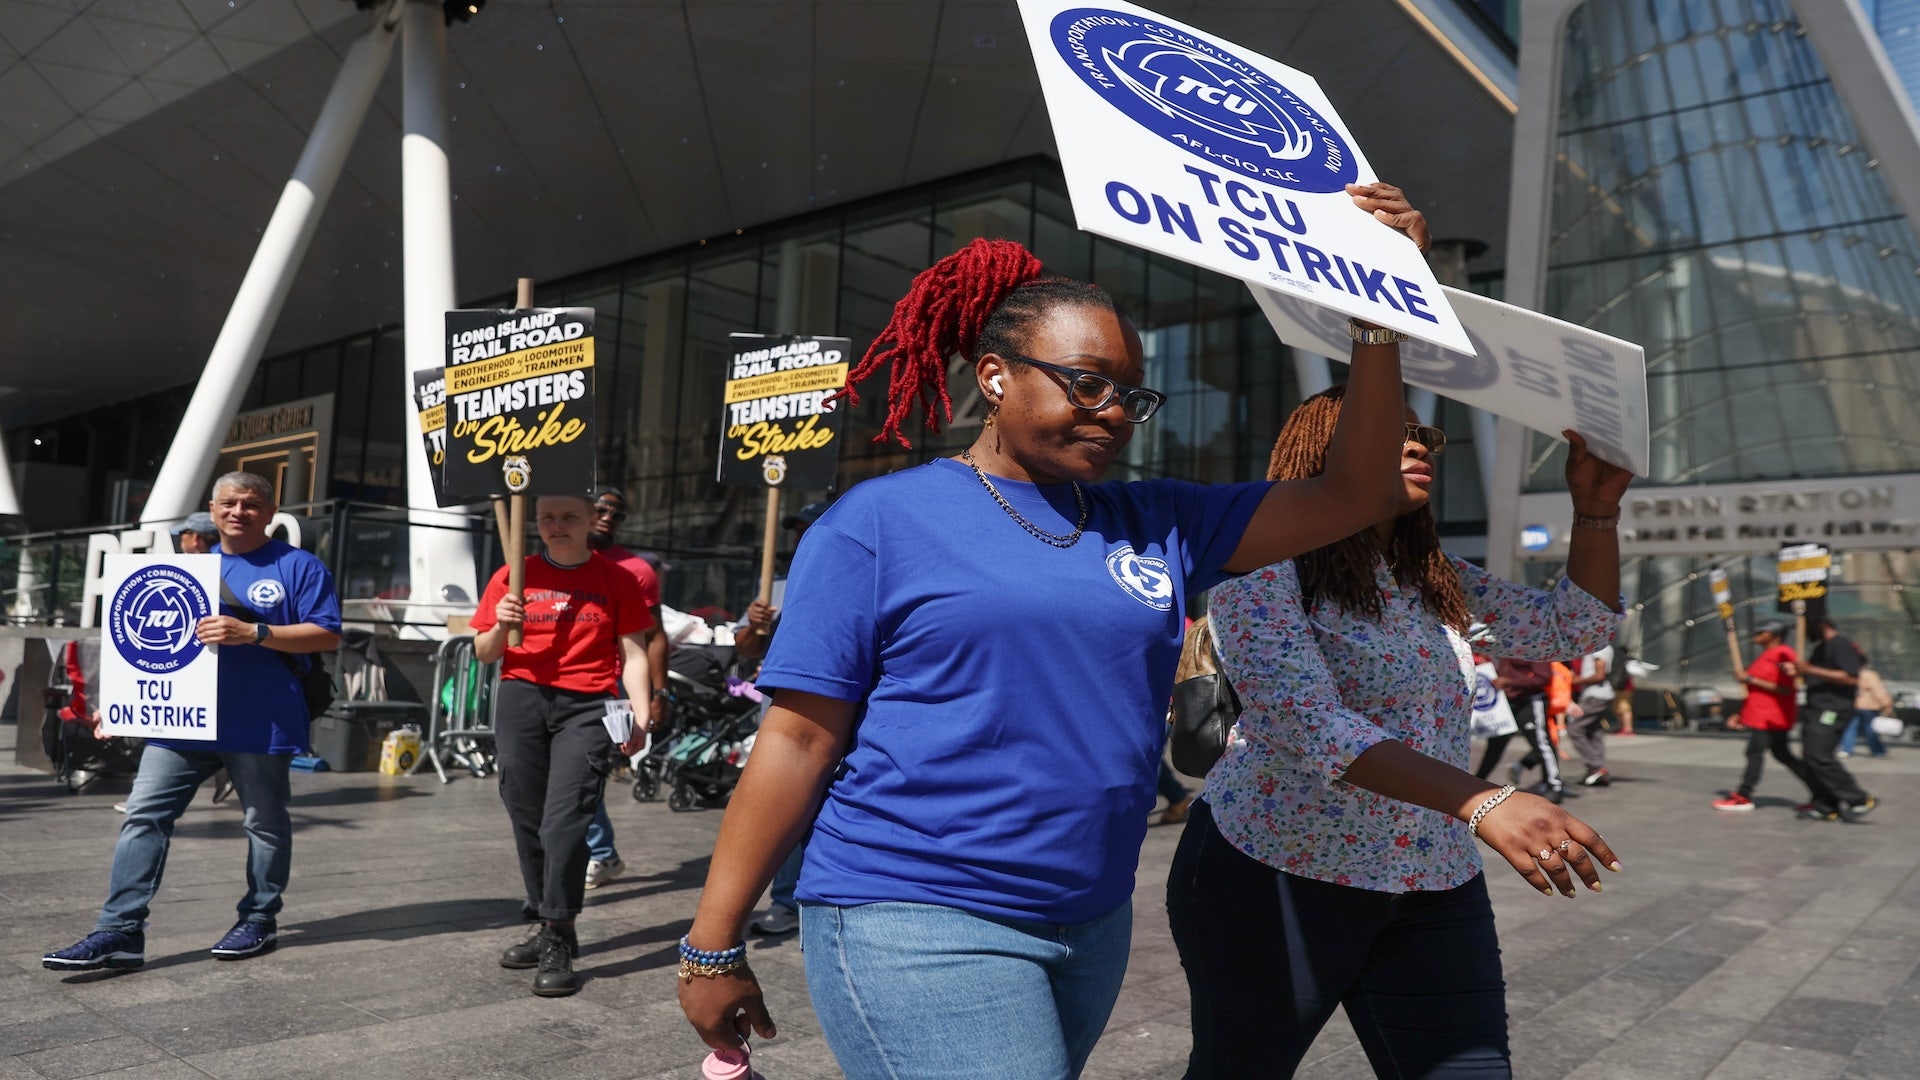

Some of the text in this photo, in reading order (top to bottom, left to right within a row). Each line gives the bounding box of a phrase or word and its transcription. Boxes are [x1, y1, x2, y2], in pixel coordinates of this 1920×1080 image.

[1067, 16, 1343, 174] TRANSPORTATION COMMUNICATIONS UNION
[1174, 75, 1259, 115] TCU
[1183, 164, 1308, 236] TCU
[1104, 181, 1440, 325] ON STRIKE
[452, 313, 556, 348] LONG ISLAND
[452, 322, 585, 365] RAIL ROAD
[454, 357, 515, 379] BROTHERHOOD
[524, 343, 585, 363] LOCOMOTIVE
[732, 349, 842, 380] RAIL ROAD
[733, 340, 820, 366] LONG ISLAND
[420, 378, 446, 397] LON
[454, 369, 510, 390] ENGINEERS
[524, 354, 585, 373] TRAINMEN
[732, 384, 777, 399] ENGINEERS
[789, 377, 839, 390] TRAINMEN
[733, 375, 783, 390] BROTHERHOOD
[790, 367, 840, 381] LOCOMOTIVE
[422, 389, 447, 411] RA
[453, 370, 586, 423] TEAMSTERS
[730, 388, 838, 426] TEAMSTERS
[453, 420, 480, 439] On
[467, 401, 586, 464] Strike
[728, 413, 835, 461] On Strike
[1630, 485, 1895, 517] PENN STATION
[113, 575, 143, 645] TRANSPORTATION
[146, 569, 207, 615] COMMUNICATIONS
[145, 610, 180, 628] TCU
[565, 612, 600, 623] CLASS
[137, 680, 172, 701] TCU
[109, 704, 207, 728] ON STRIKE
